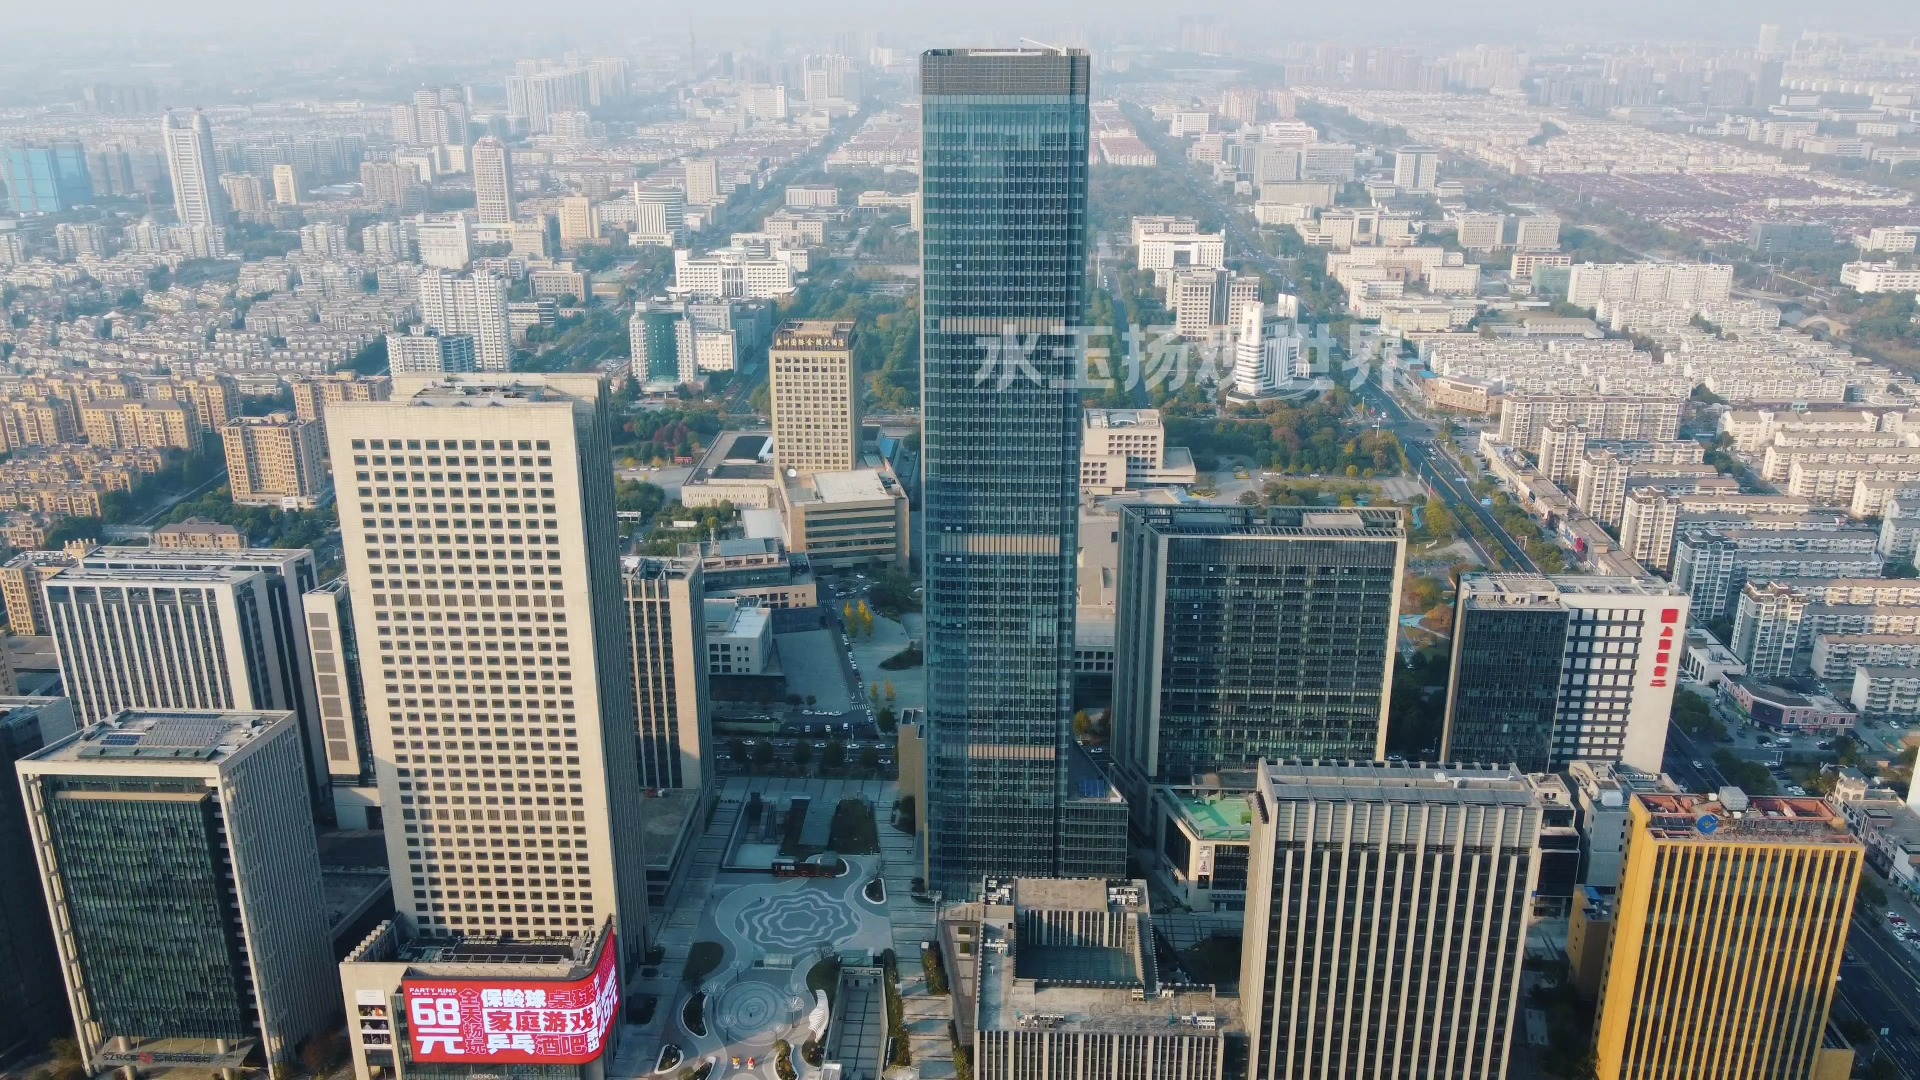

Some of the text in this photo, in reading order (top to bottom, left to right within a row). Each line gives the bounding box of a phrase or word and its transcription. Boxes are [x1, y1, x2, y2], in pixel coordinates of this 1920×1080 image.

[411, 997, 461, 1026] 68
[458, 988, 486, 1055] 全天畅玩
[487, 1006, 595, 1033] 家庭游戏
[416, 1027, 465, 1055] 元
